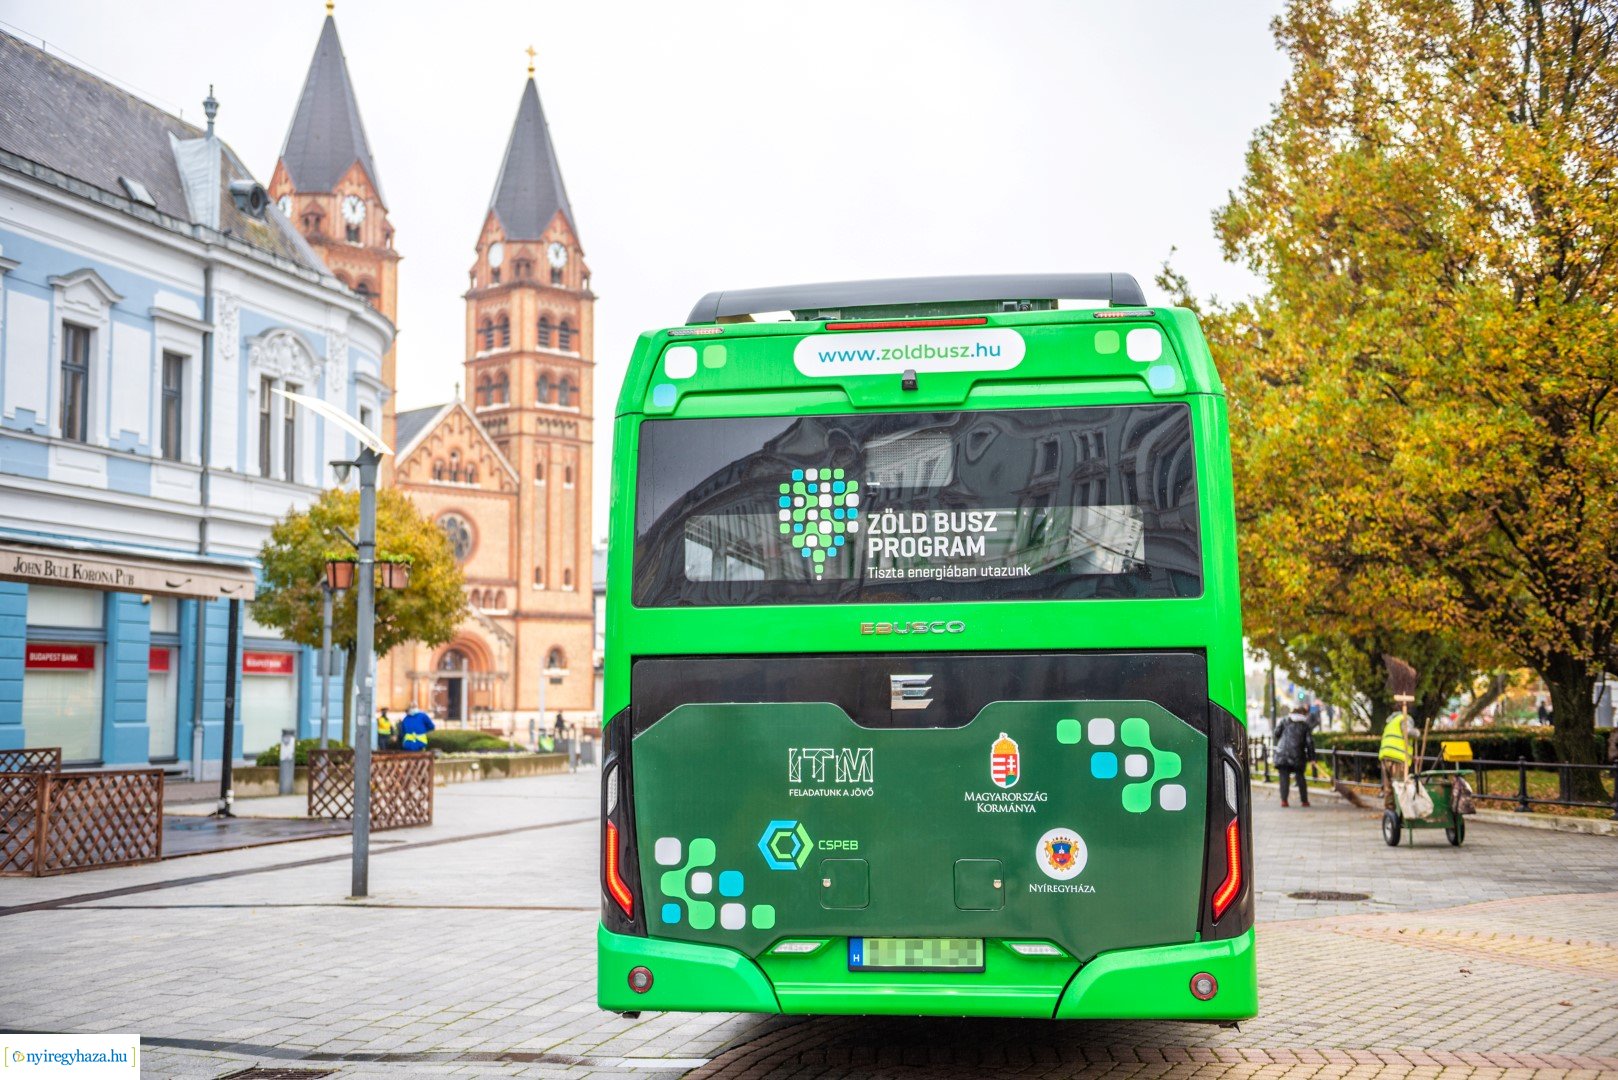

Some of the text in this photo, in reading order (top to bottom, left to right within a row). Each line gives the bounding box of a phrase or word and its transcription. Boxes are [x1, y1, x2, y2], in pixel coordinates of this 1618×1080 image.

[818, 343, 1001, 363] www.zoldbusz.hu
[867, 508, 998, 535] ZÖLD BUSZ
[867, 535, 986, 558] PROGRAM
[867, 564, 1031, 581] Tiszta energiában utazunk
[860, 620, 966, 635] EBUSCO
[29, 652, 78, 662] BUDAPEST BANK
[788, 747, 874, 783] ITM
[789, 787, 874, 797] FELADATUNK A JÖVŐ
[818, 840, 859, 850] CSPEB
[853, 954, 860, 962] H
